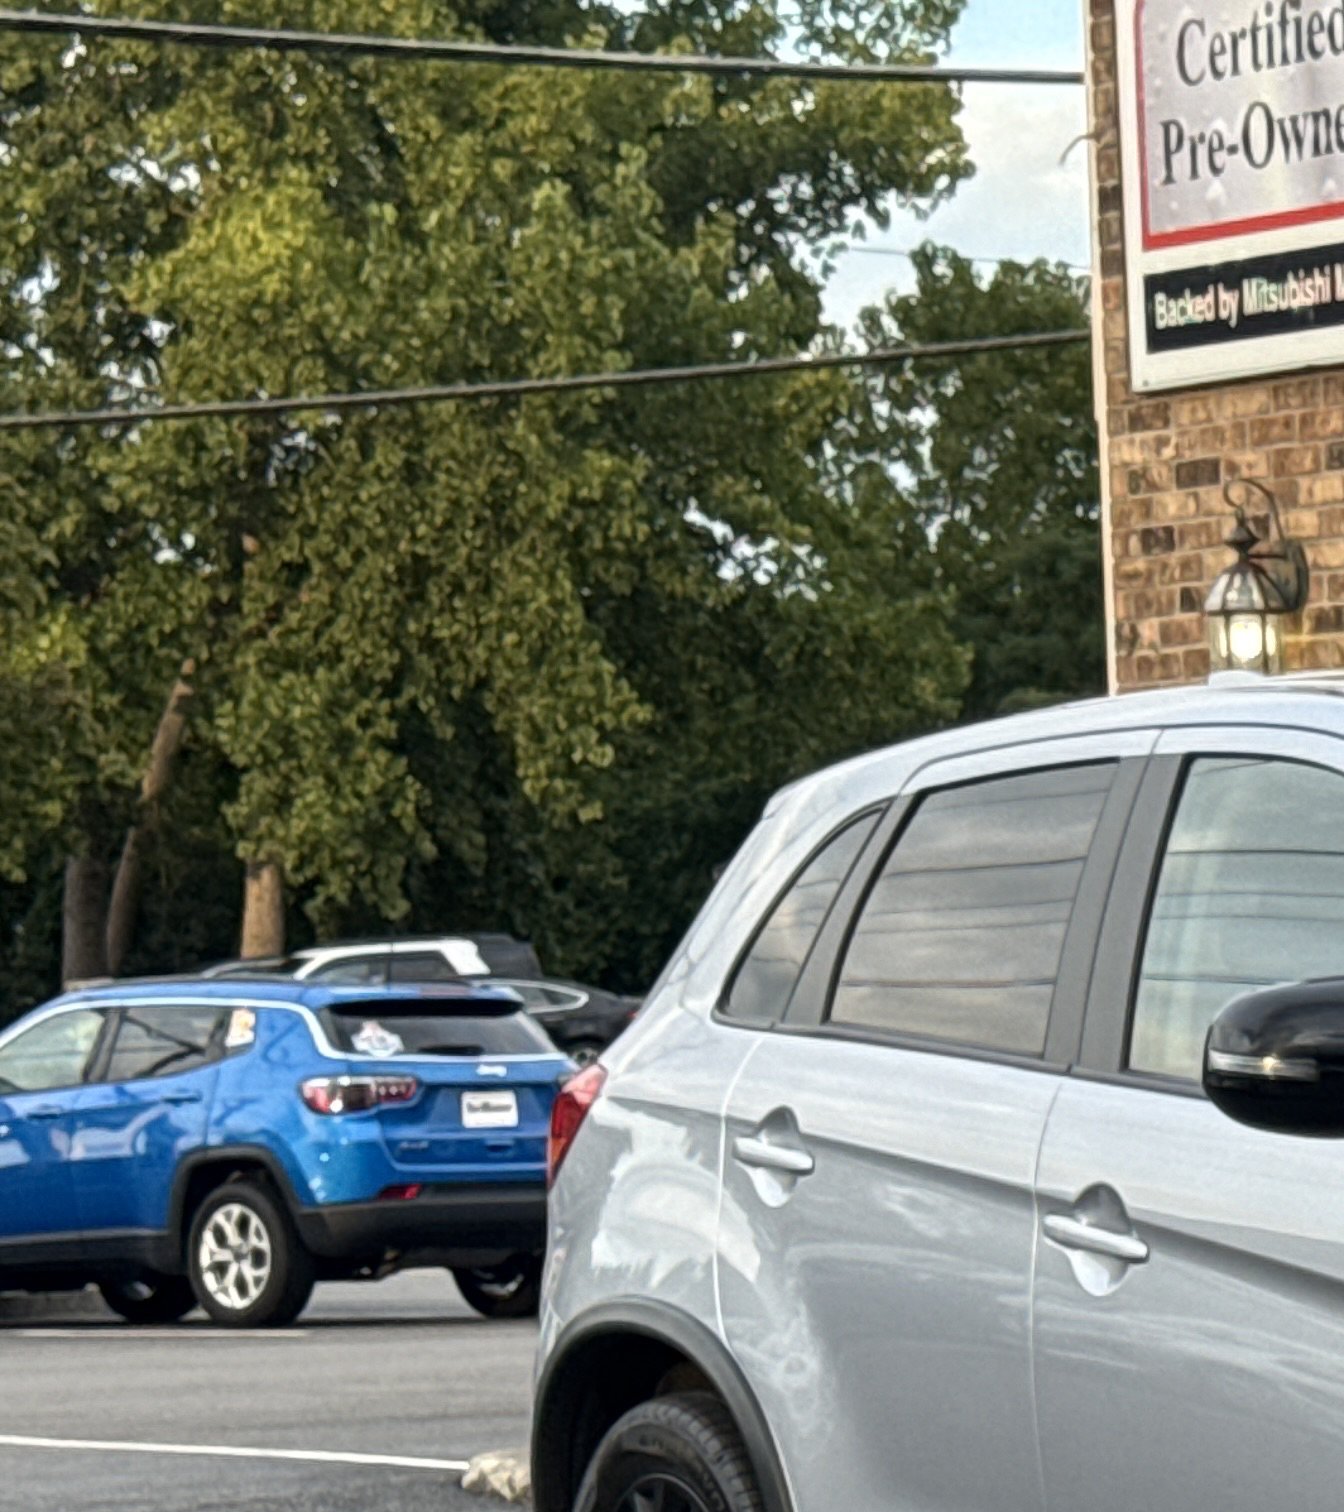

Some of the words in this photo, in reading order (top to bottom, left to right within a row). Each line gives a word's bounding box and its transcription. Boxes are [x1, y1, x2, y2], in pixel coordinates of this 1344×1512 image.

[1154, 285, 1215, 330] Backed
[1219, 282, 1240, 328] by
[1242, 265, 1331, 316] Mitsubishi
